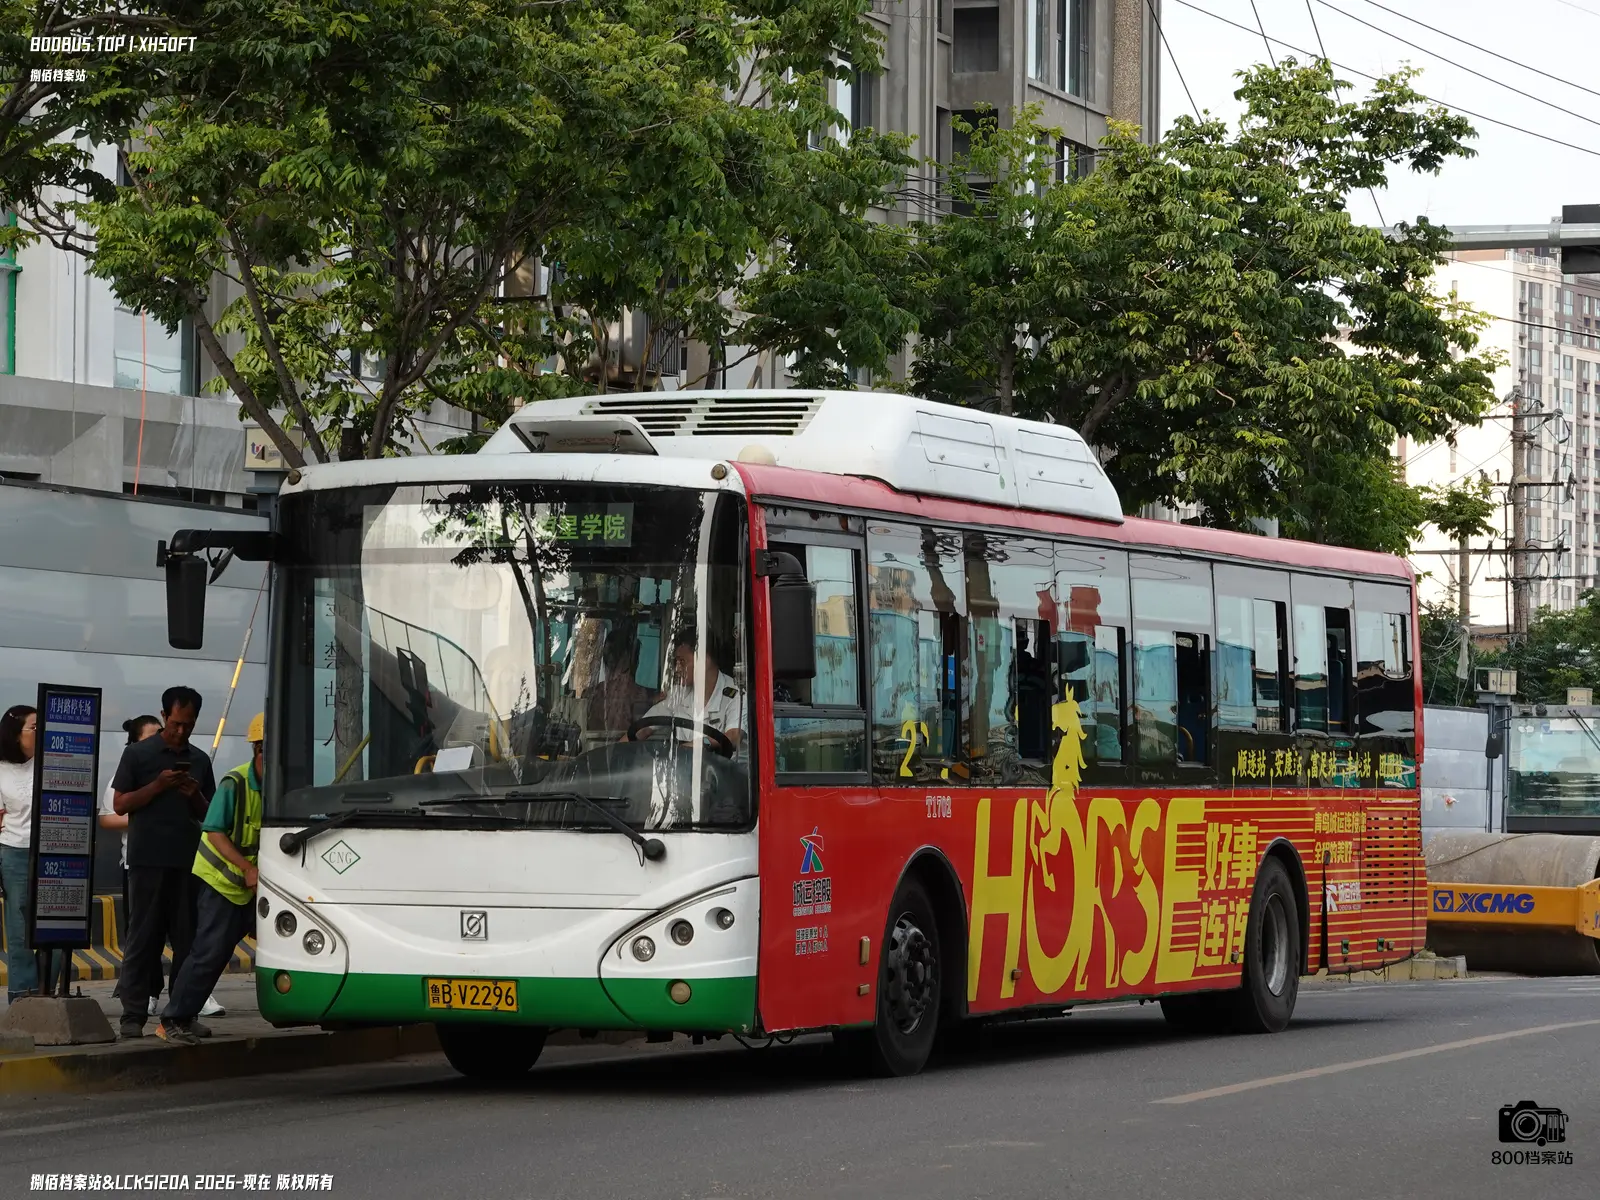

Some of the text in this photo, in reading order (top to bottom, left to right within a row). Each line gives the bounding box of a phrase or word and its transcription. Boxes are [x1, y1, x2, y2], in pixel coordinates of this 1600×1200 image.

[49, 697, 91, 716] 开封路停车场
[51, 735, 65, 750] 208
[48, 798, 62, 813] 361
[925, 796, 951, 818] T1702
[328, 850, 352, 865] CNG
[1203, 821, 1259, 891] 好事
[44, 861, 59, 876] 362
[793, 877, 832, 906] 城运控股
[968, 797, 1206, 1002] HORSE
[1454, 892, 1536, 914] XCMG
